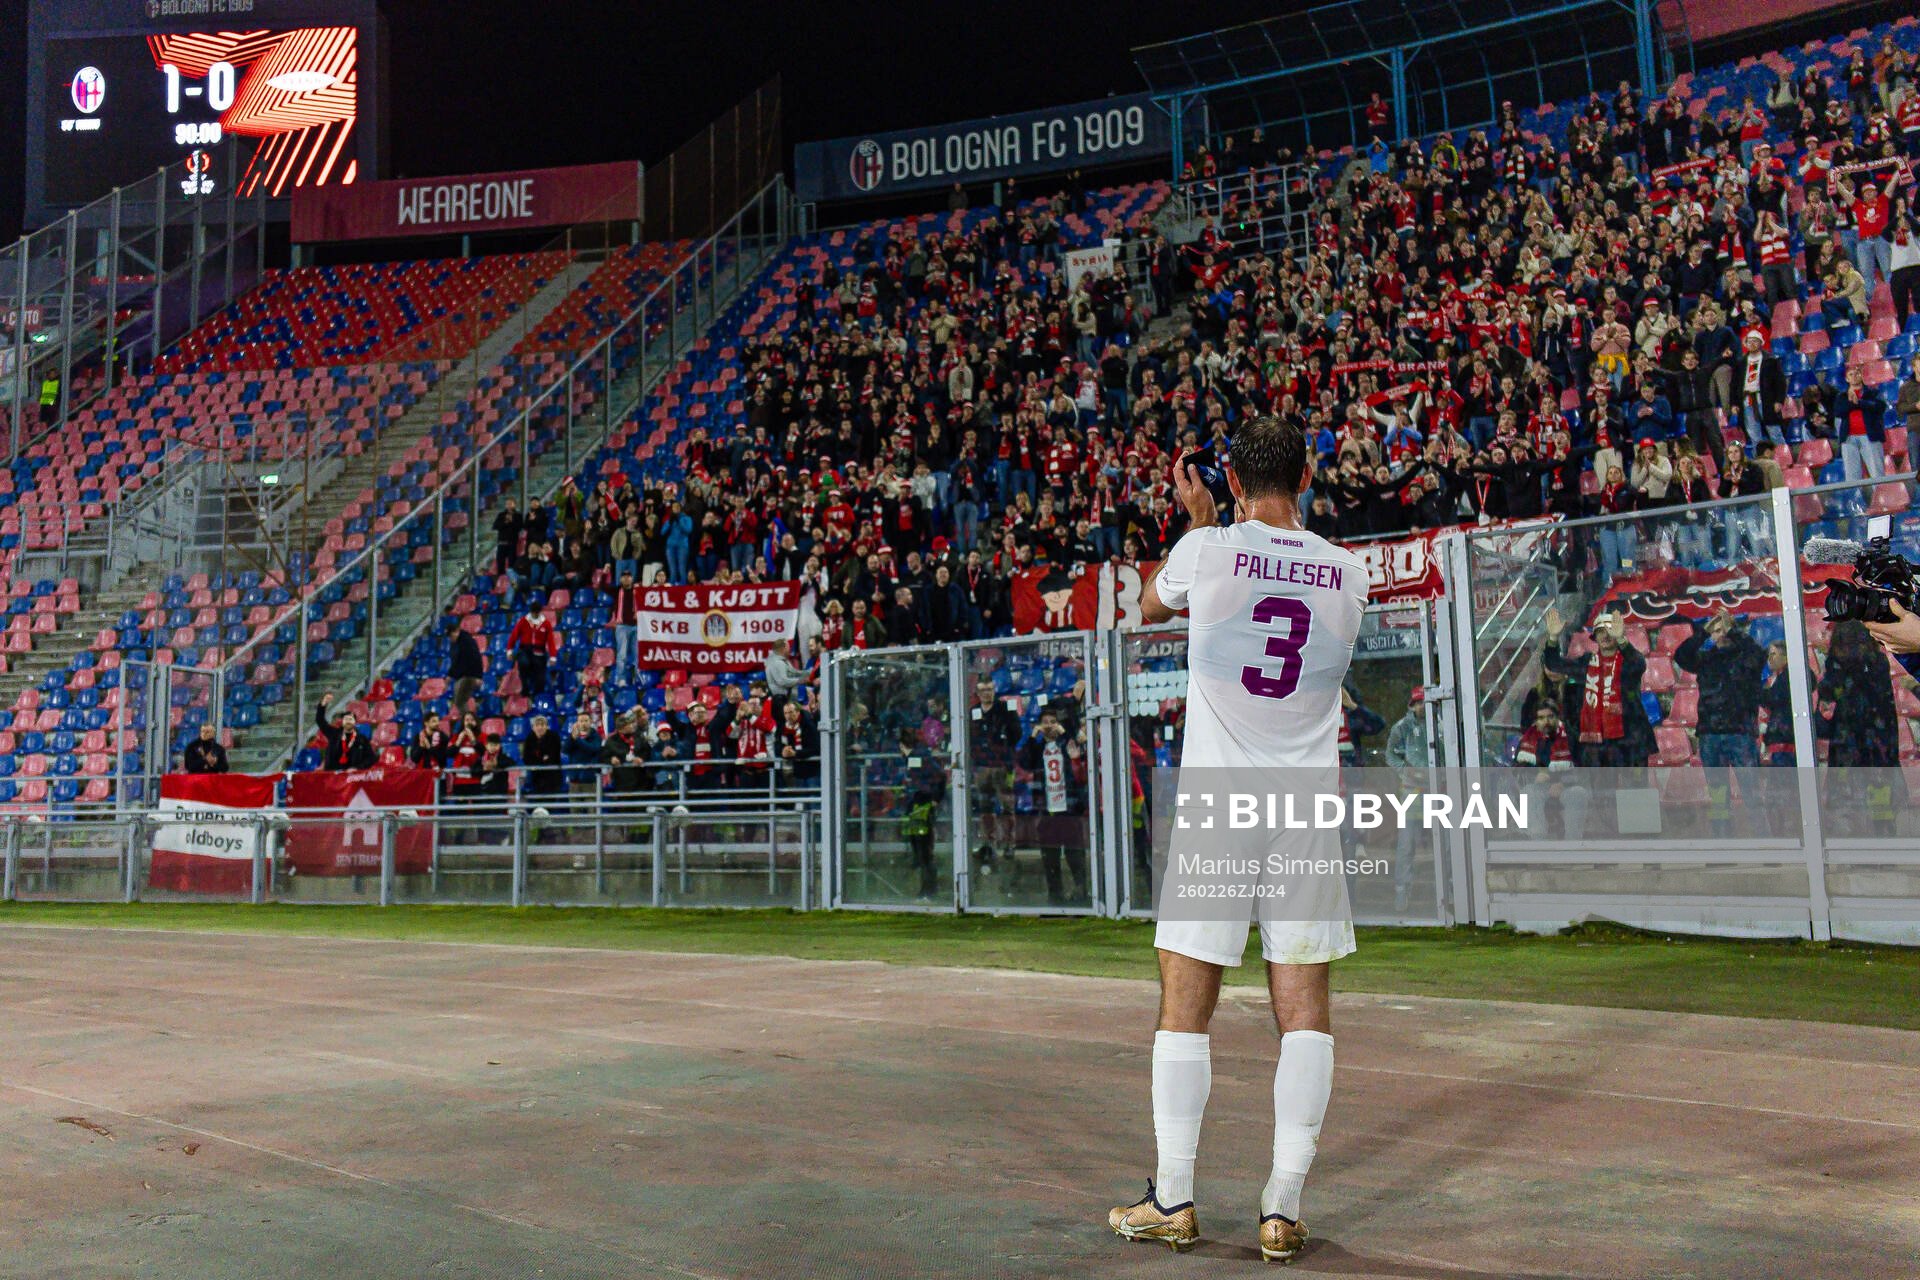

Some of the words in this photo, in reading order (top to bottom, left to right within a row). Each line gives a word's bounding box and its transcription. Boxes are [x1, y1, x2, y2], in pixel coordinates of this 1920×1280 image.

[892, 125, 1020, 181] BOLOGNA
[1032, 118, 1067, 161] FC
[1075, 105, 1144, 155] 1909
[398, 178, 534, 225] WEAREONE
[1271, 537, 1282, 545] FOR
[1282, 539, 1304, 548] BERGEN
[1233, 552, 1342, 591] PALLESEN
[644, 590, 676, 608] ØL
[684, 590, 699, 608] &
[708, 586, 790, 608] KJØTT
[650, 619, 689, 634] SKB
[740, 618, 785, 634] 1908
[697, 650, 721, 664] OG
[724, 647, 772, 664] SKÅL
[1240, 595, 1313, 699] 3
